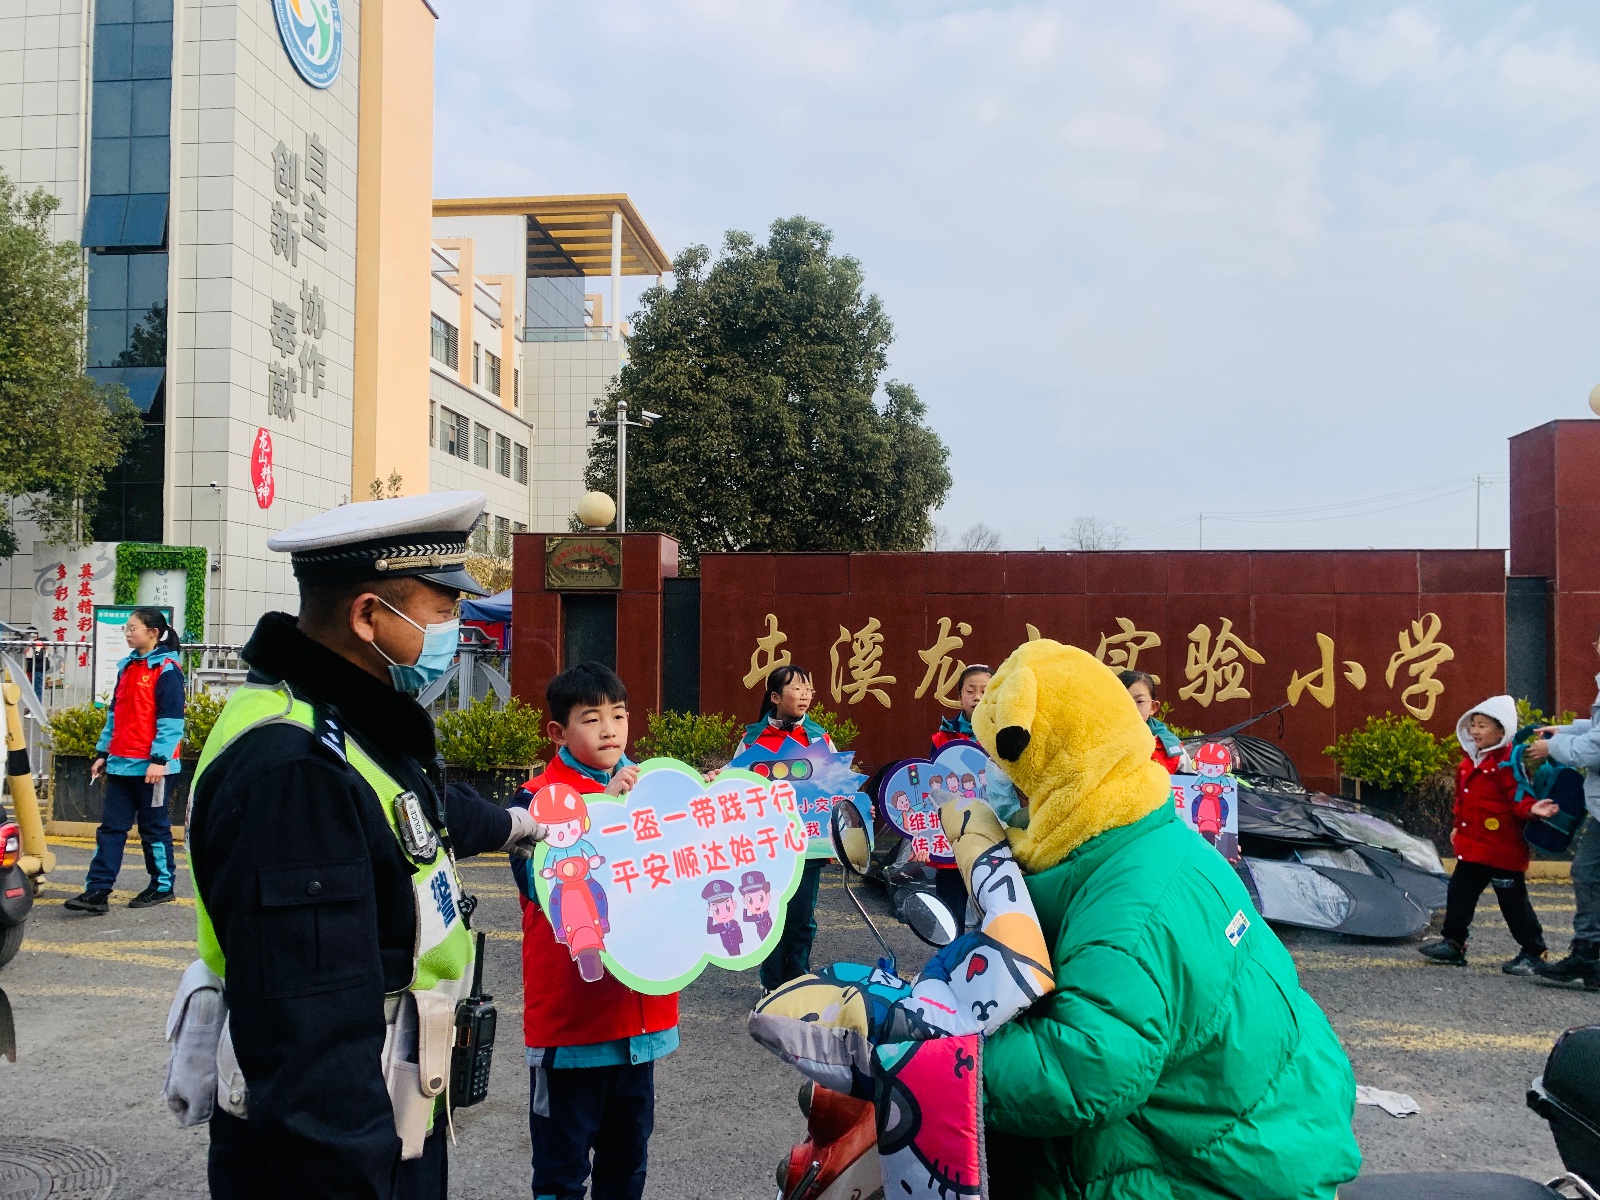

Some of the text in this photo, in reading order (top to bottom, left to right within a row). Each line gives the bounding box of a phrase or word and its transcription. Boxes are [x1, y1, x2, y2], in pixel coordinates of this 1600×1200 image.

[268, 139, 300, 422] 创新 奉献
[299, 132, 327, 398] 自主 协作
[256, 430, 271, 506] 龙山精神
[52, 563, 69, 642] 多彩教育
[743, 612, 1454, 721] 屯溪龙实验小学
[410, 809, 423, 836] POLICE
[601, 783, 795, 842] 一盔一带践于行
[611, 822, 806, 893] 平安顺达始于心
